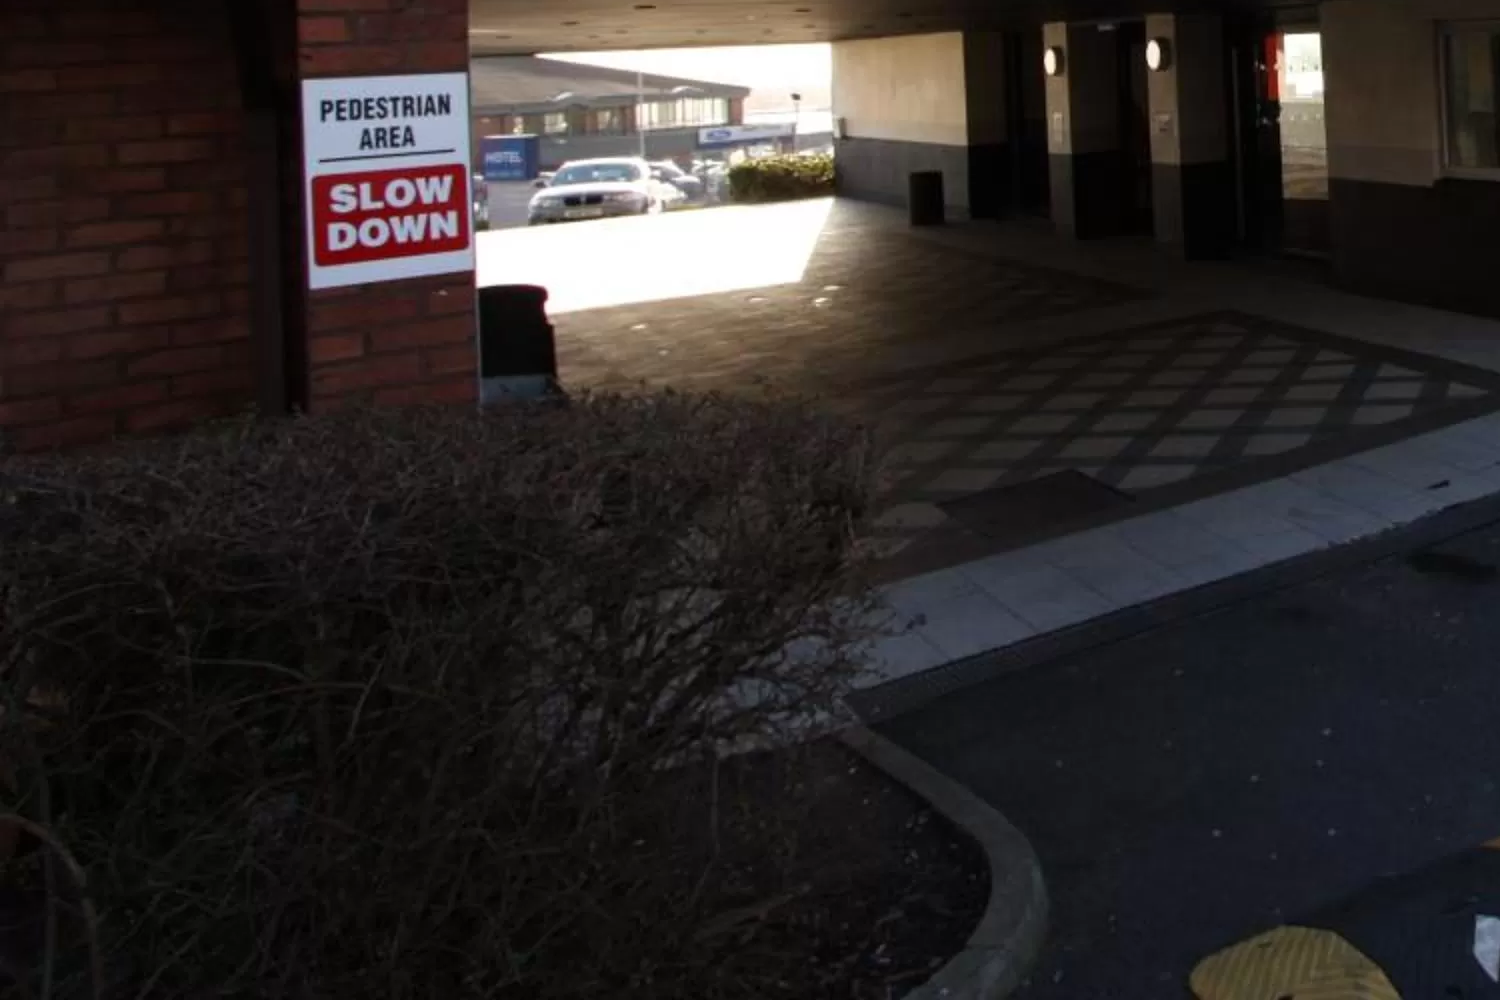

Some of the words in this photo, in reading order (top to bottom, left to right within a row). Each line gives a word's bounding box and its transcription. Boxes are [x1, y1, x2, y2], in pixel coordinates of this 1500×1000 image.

[319, 93, 452, 123] PEDESTRIAN
[358, 125, 416, 150] AREA
[329, 175, 454, 214] SLOW
[326, 211, 459, 252] DOWN
